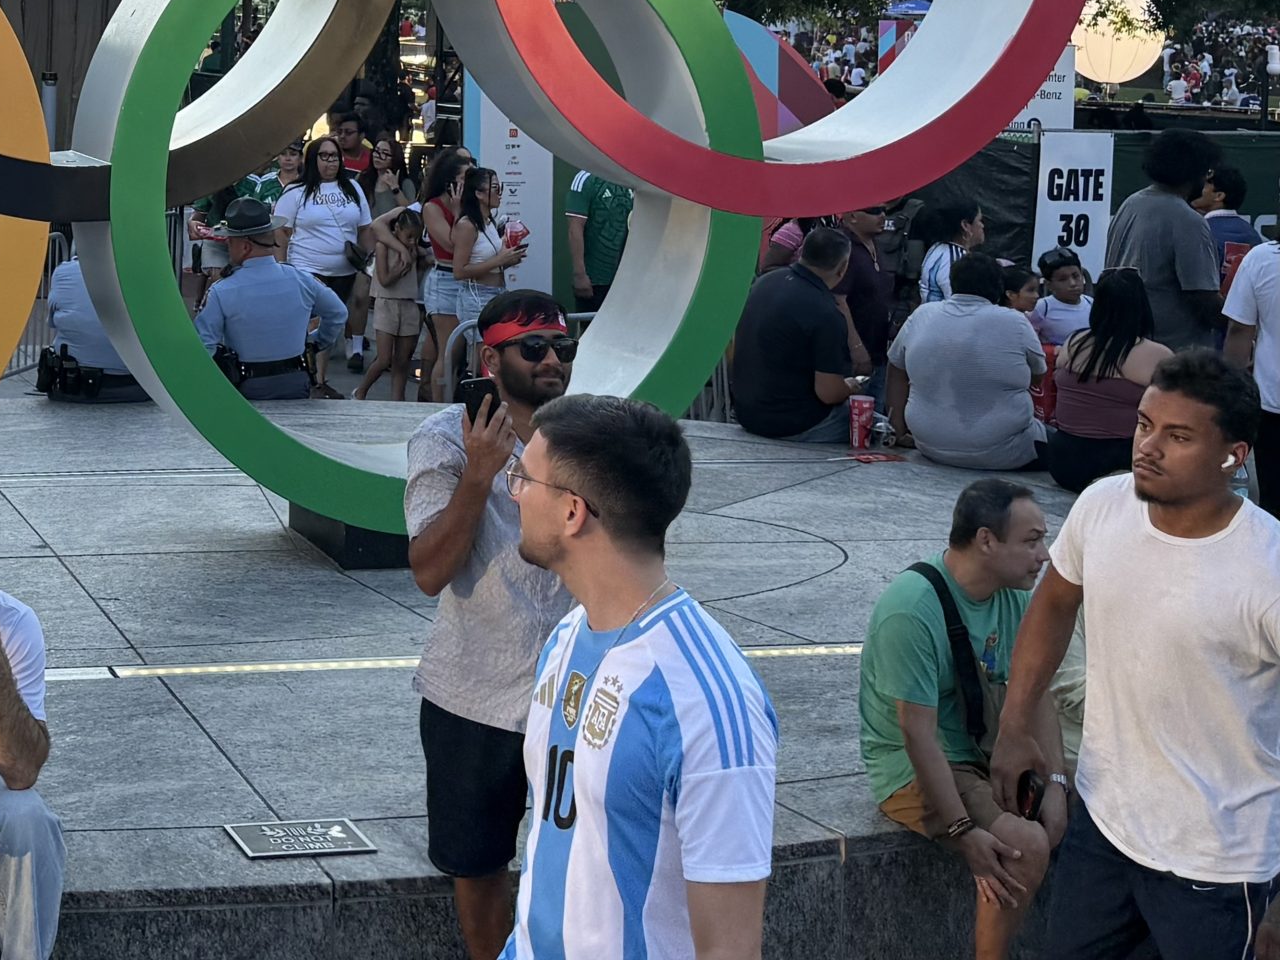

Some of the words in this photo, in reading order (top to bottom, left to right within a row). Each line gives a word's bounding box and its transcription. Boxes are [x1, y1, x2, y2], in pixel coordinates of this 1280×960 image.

[1047, 168, 1105, 202] GATE
[1057, 213, 1090, 248] 30
[542, 744, 577, 830] 10
[298, 835, 333, 843] NOT
